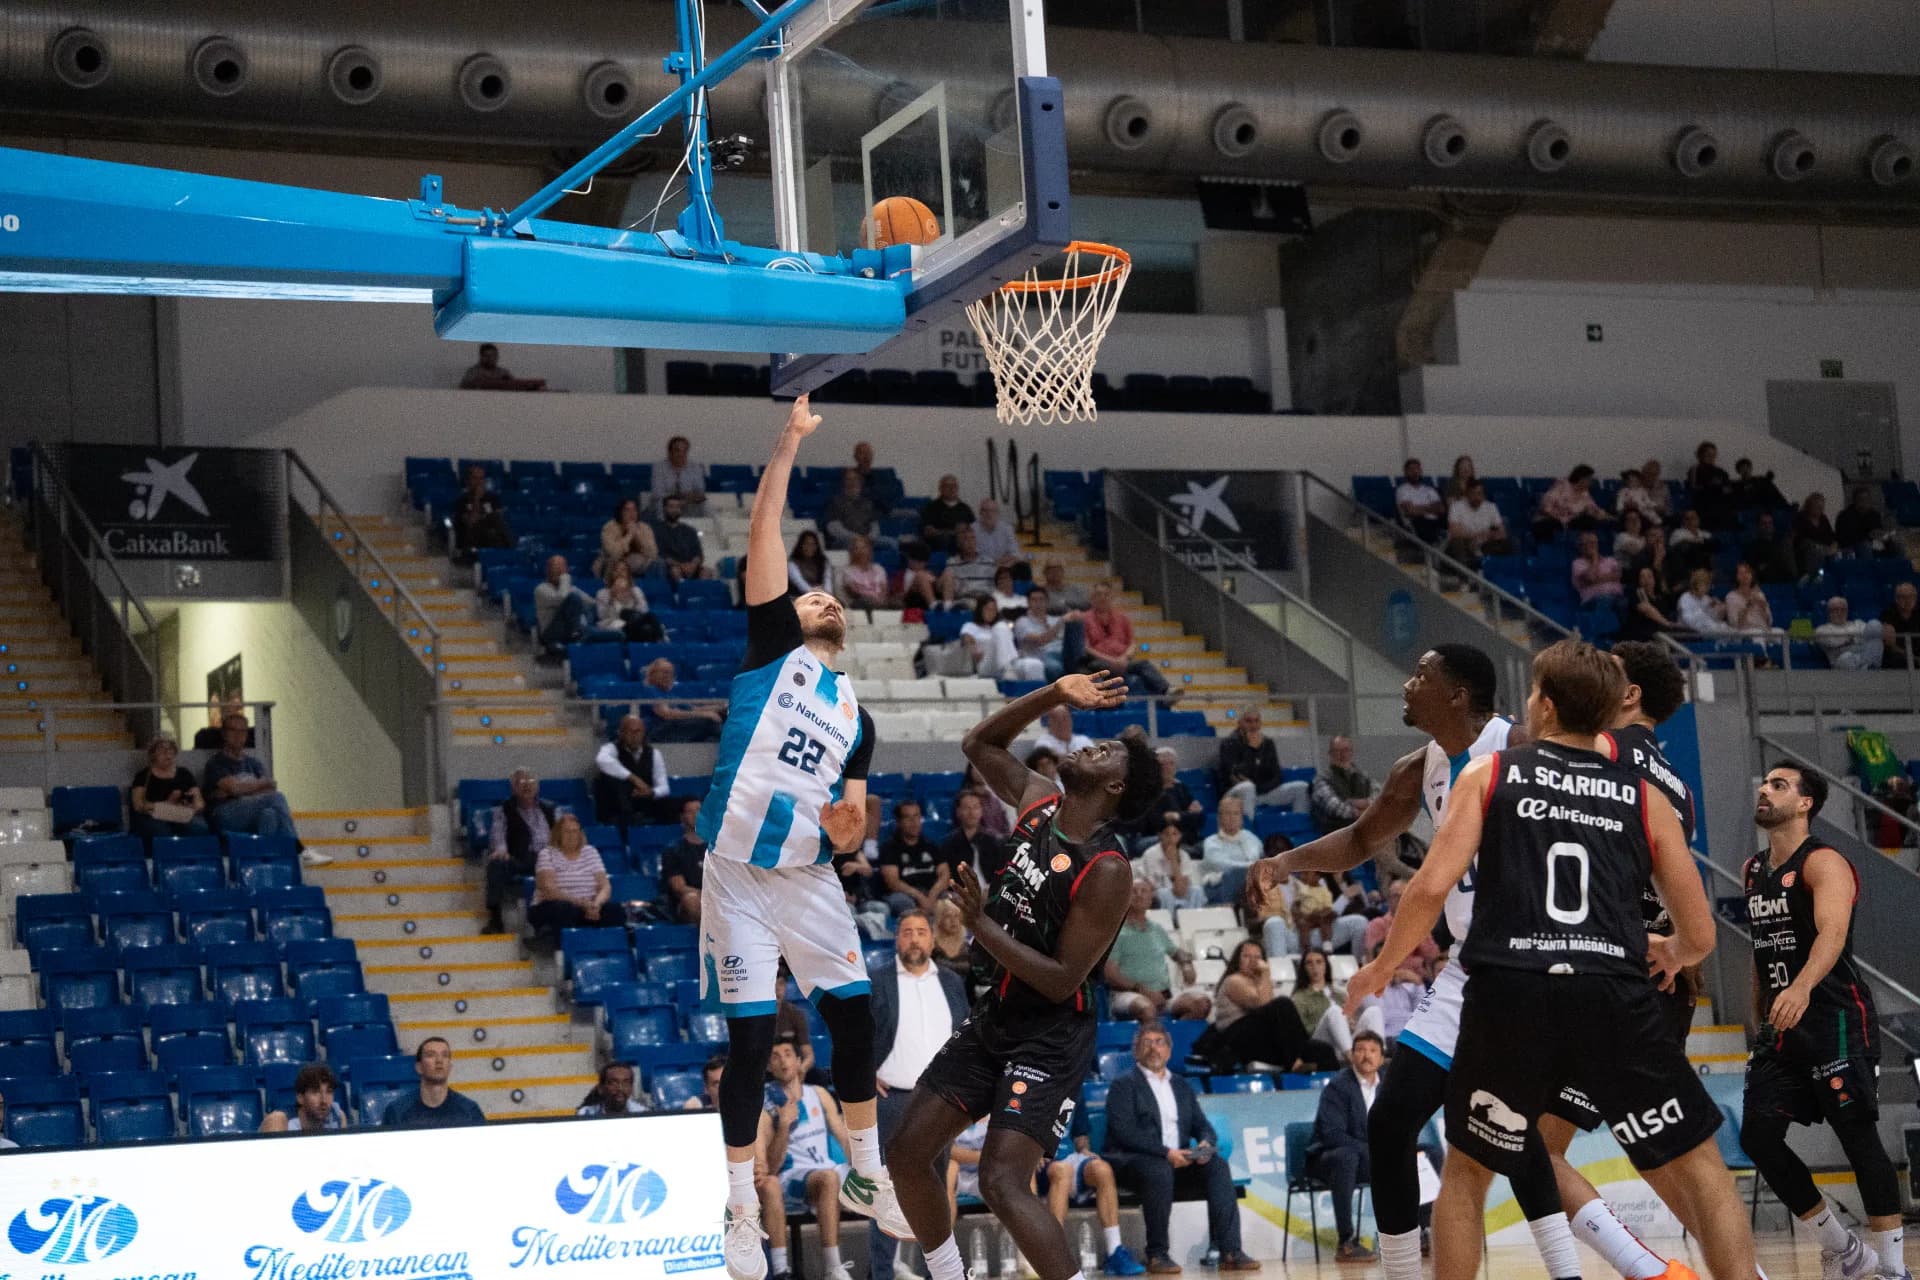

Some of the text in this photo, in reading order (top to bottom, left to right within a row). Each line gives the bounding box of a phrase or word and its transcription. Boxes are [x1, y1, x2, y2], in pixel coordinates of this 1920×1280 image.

[0, 214, 20, 232] 0
[102, 529, 229, 554] CaixaBank
[795, 702, 850, 749] Naturklima
[777, 727, 826, 776] 22
[1633, 748, 1647, 768] P.
[1507, 764, 1636, 805] A. SCARIOLO
[1548, 805, 1624, 832] AirEuropa
[1546, 841, 1590, 925] 0
[1748, 891, 1789, 919] fibwi
[1537, 939, 1567, 951] SANTA
[1569, 940, 1625, 959] MAGDALENA
[1768, 961, 1789, 989] 30
[1479, 1129, 1524, 1152] BALEARES
[509, 1226, 723, 1268] Mediterranean
[244, 1245, 470, 1280] Mediterranean
